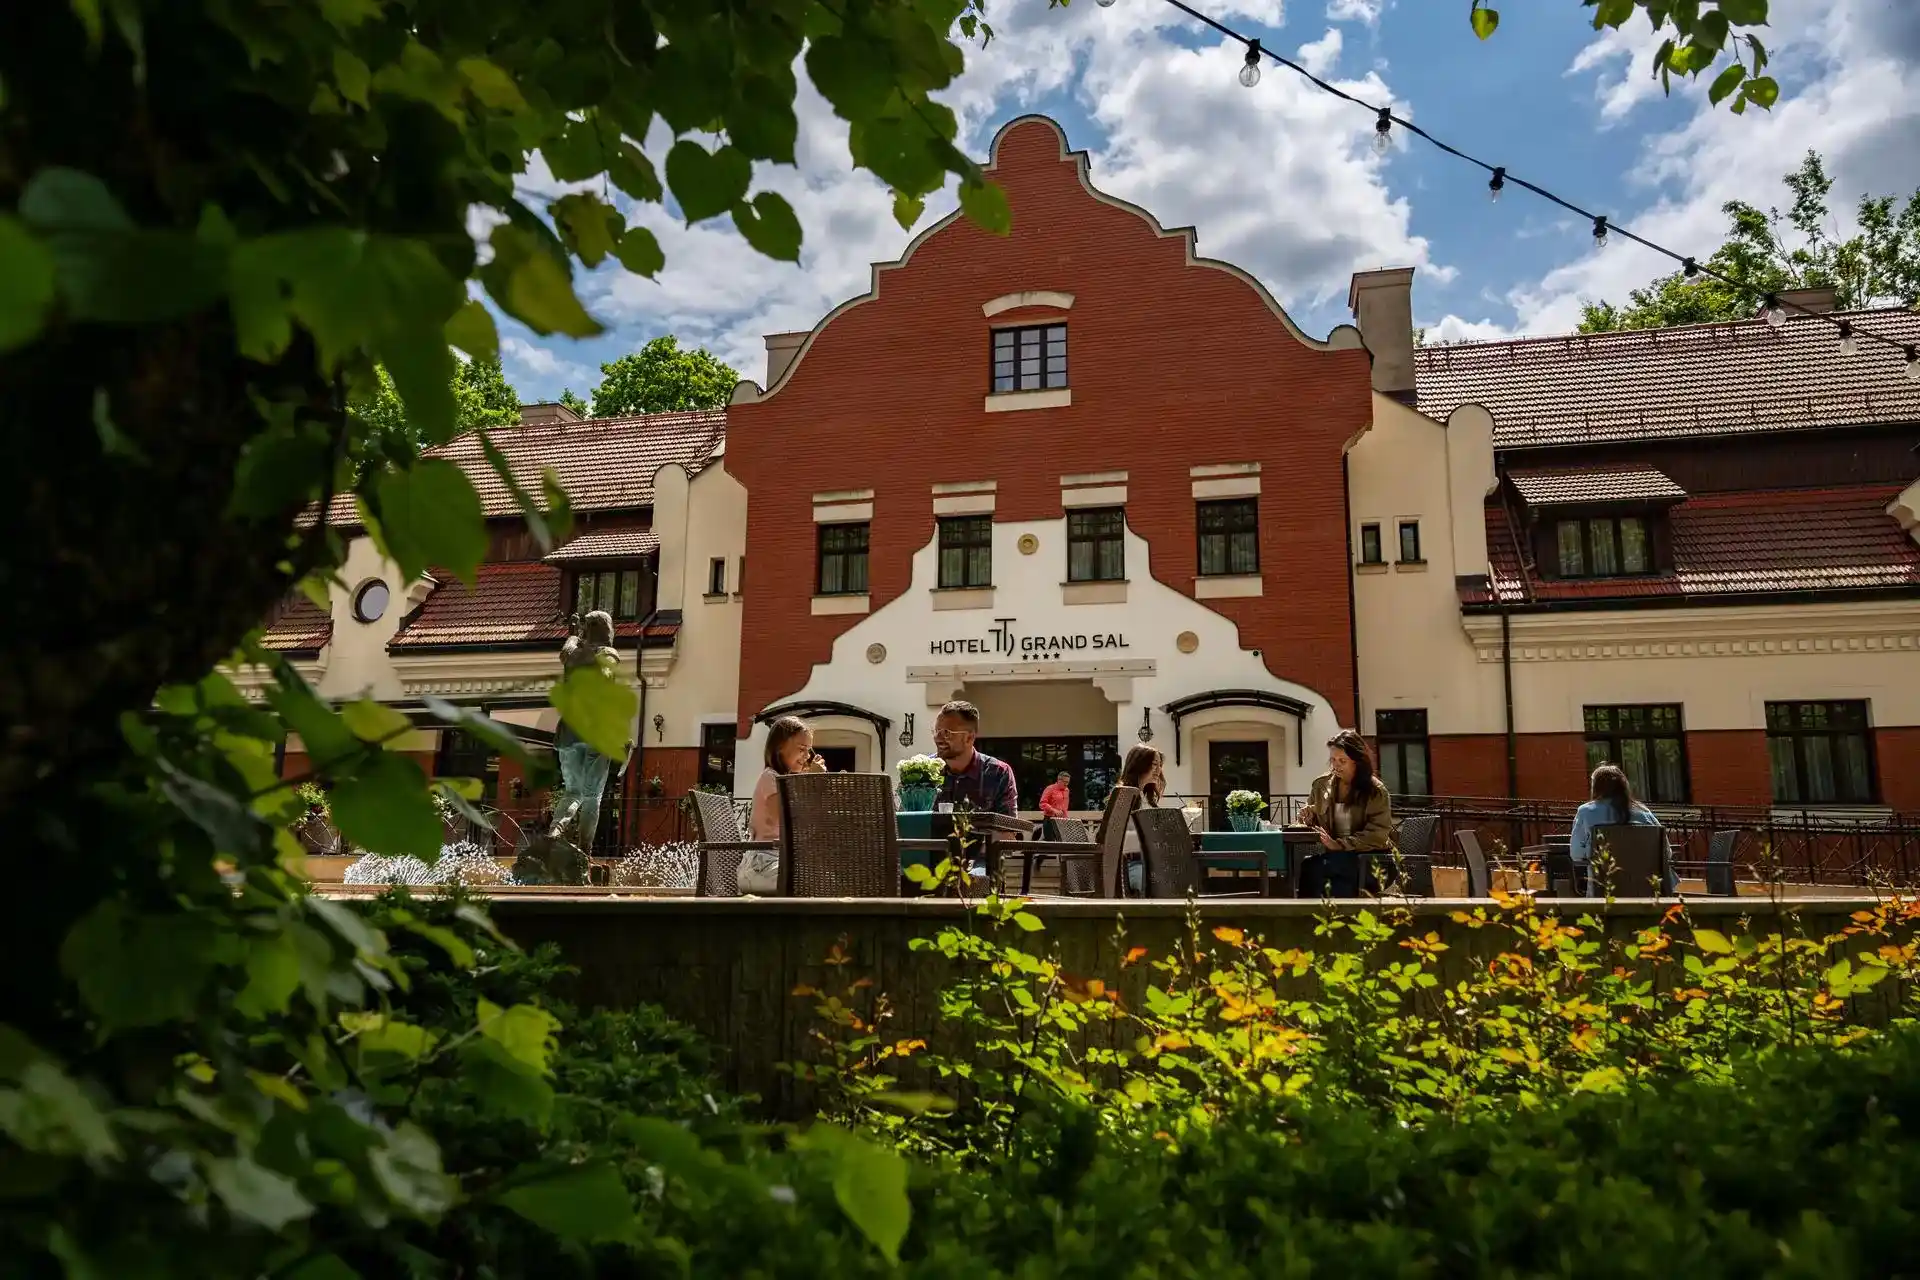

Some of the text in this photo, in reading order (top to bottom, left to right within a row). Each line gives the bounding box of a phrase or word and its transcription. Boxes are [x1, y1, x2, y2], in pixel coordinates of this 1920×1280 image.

[930, 639, 991, 655] HOTEL
[1021, 634, 1088, 652] GRAND
[1092, 633, 1130, 649] SAL
